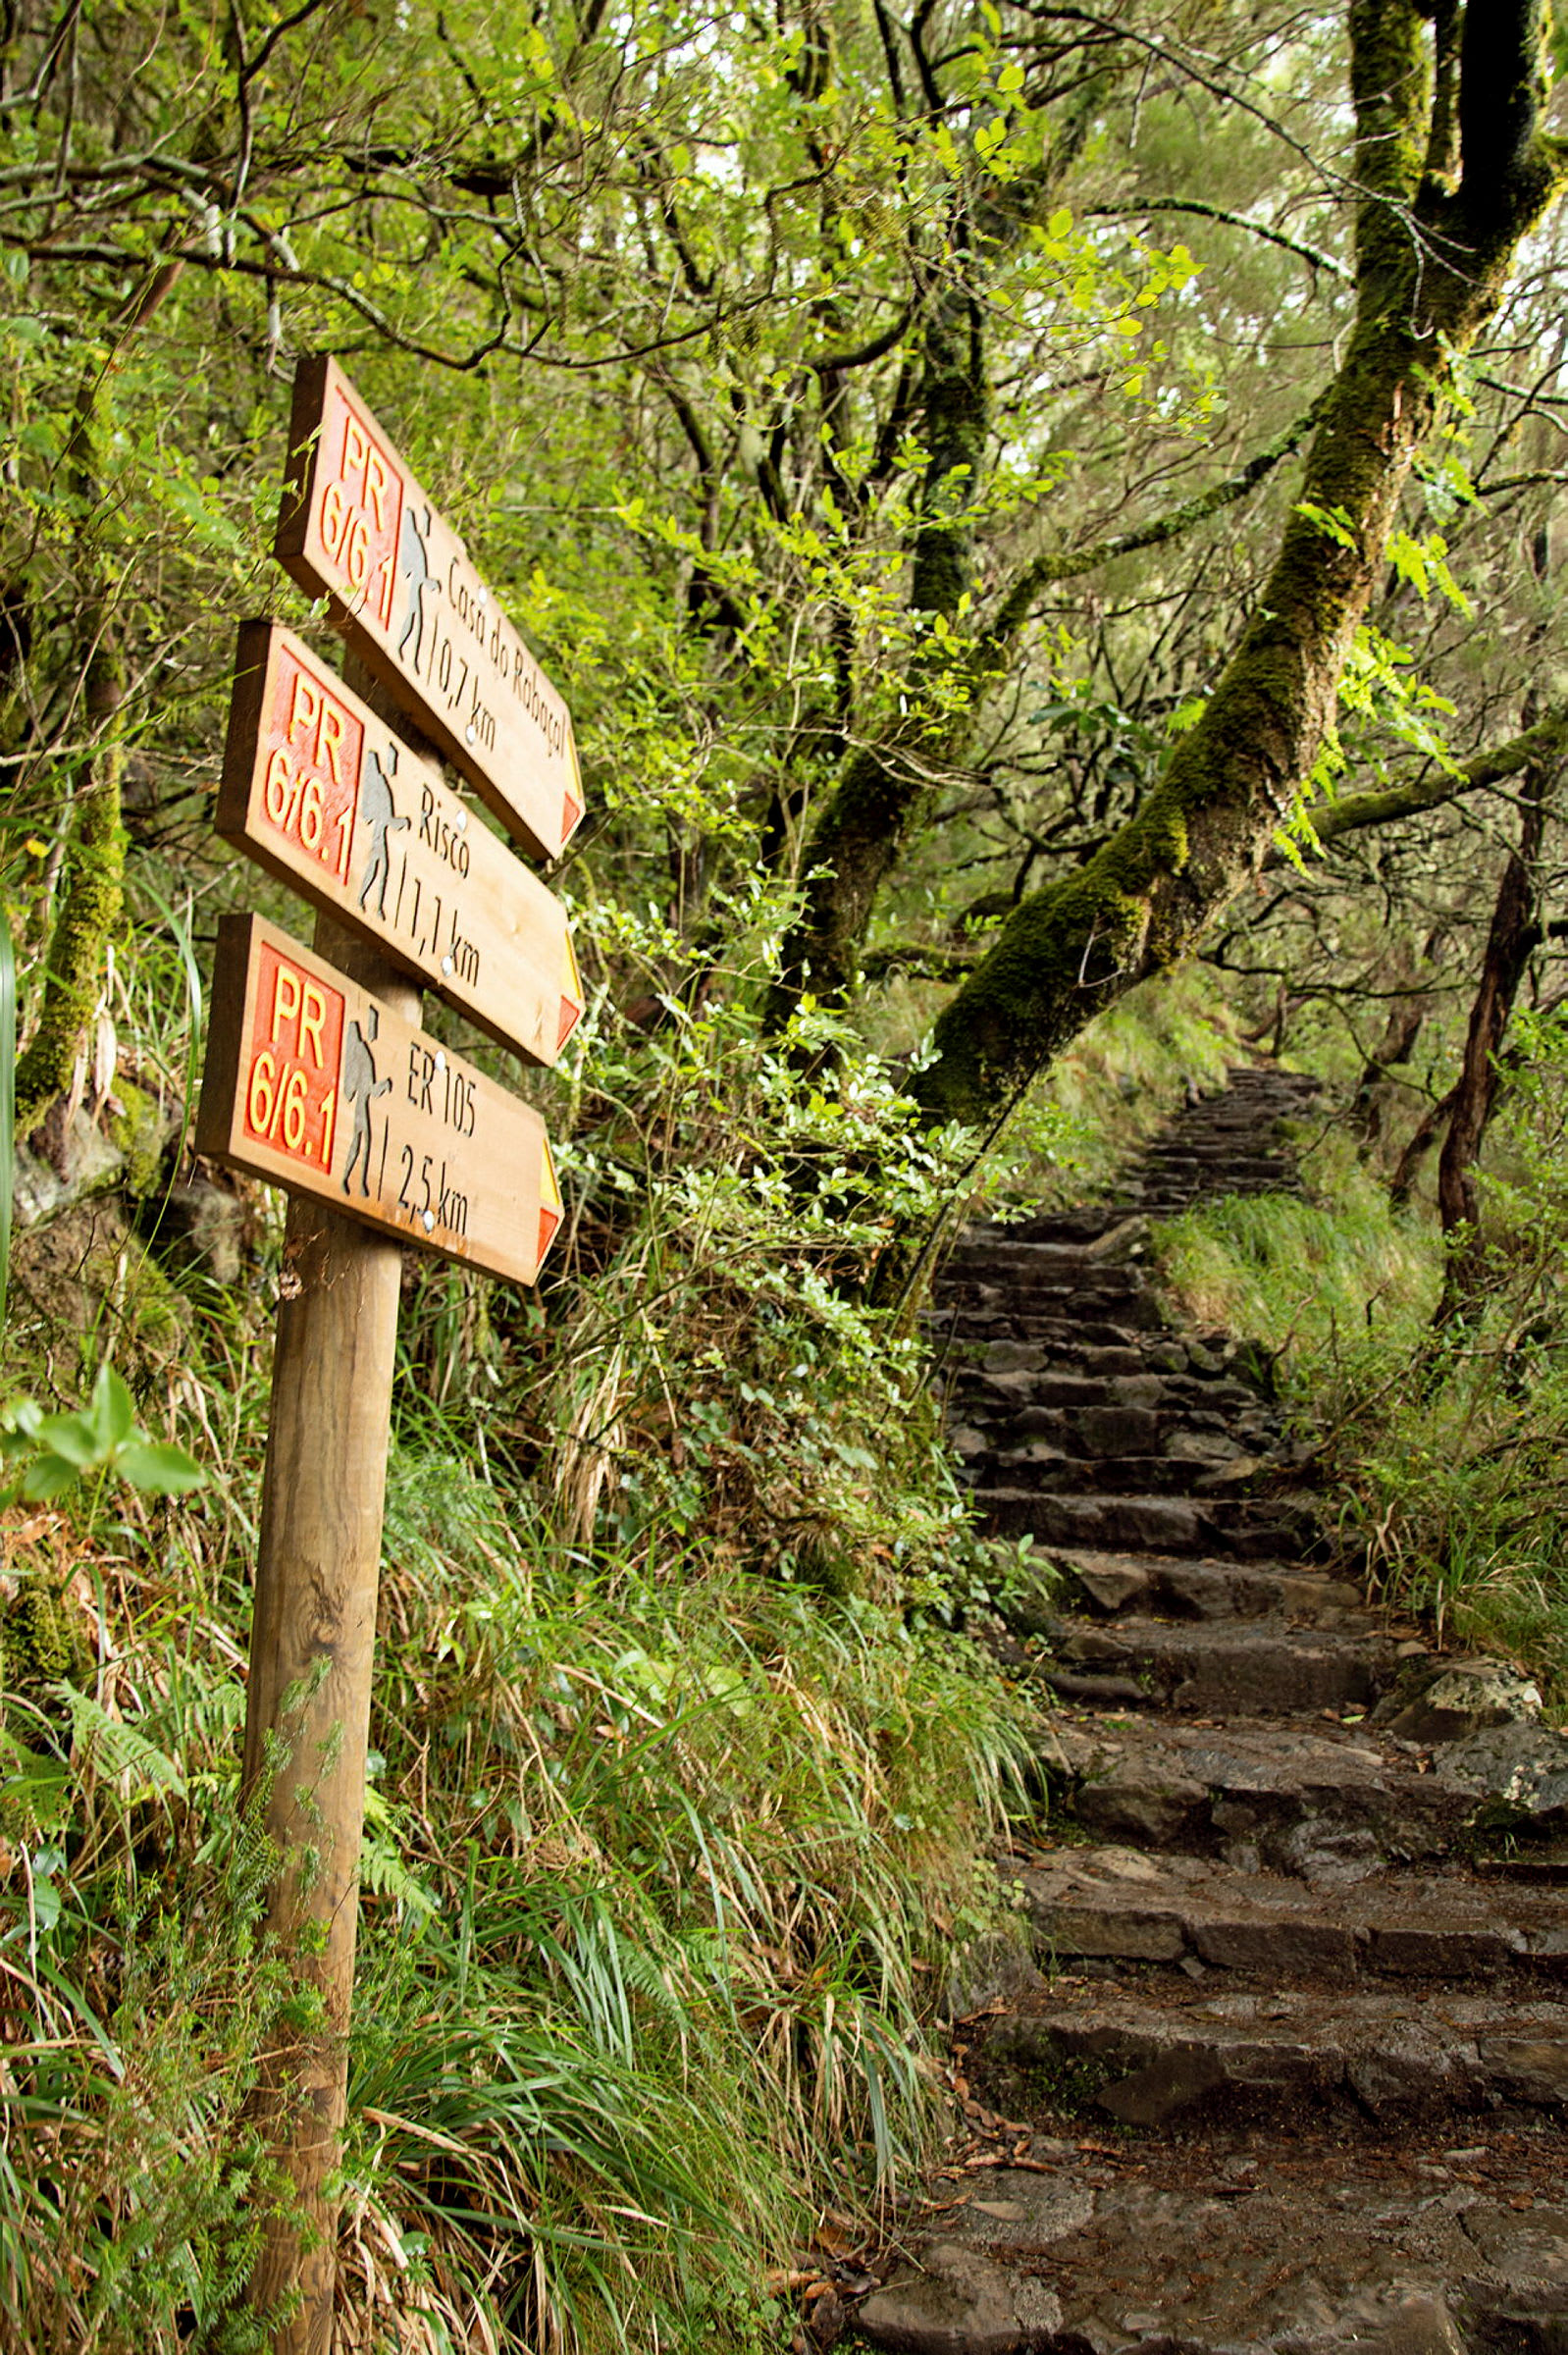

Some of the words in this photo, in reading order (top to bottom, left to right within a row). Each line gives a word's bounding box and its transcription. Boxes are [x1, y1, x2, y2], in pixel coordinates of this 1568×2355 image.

[340, 414, 384, 532] PR
[320, 482, 395, 628] 6/6.1
[439, 638, 469, 710] 0,7
[470, 674, 496, 752] km
[449, 556, 485, 646] Casa
[491, 617, 508, 678] do
[512, 648, 566, 760] Rabaçal
[288, 672, 344, 785] PR
[265, 748, 353, 875] 6/6.1
[419, 784, 471, 879] Risco
[449, 910, 481, 986] km
[272, 964, 325, 1070] PR
[248, 1051, 336, 1166] 6/6.1
[407, 1041, 435, 1116] ER
[443, 1063, 477, 1138] 105
[397, 1144, 433, 1224] 2,5
[439, 1161, 469, 1235] km
